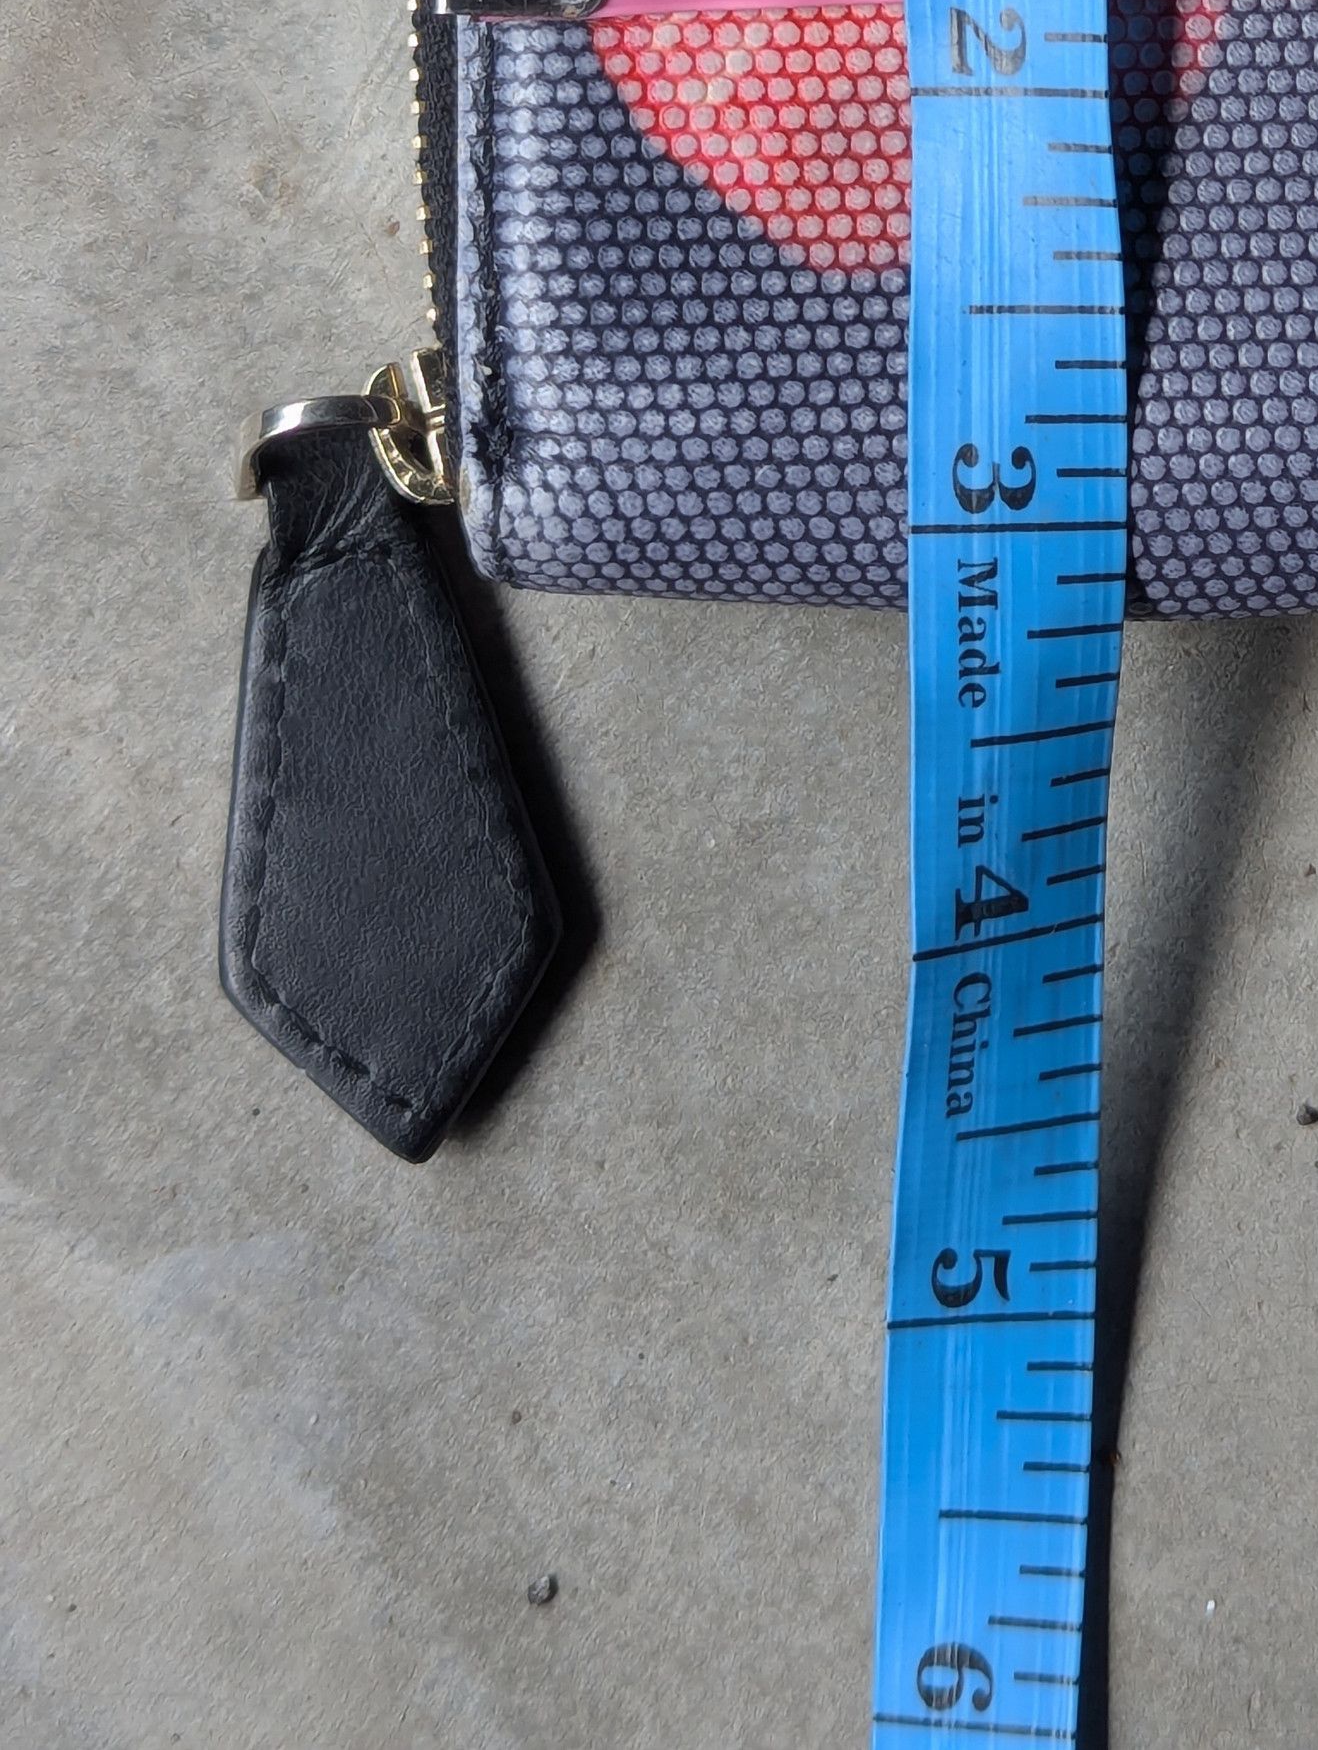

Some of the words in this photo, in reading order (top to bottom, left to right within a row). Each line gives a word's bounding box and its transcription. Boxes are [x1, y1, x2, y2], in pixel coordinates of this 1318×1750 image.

[949, 6, 1027, 77] 2
[952, 442, 1037, 515] 3
[956, 556, 1001, 709] Made
[957, 793, 999, 849] in
[954, 864, 1030, 941] 4
[945, 970, 993, 1120] China
[930, 1246, 1011, 1309] 5
[915, 1641, 994, 1713] 6
